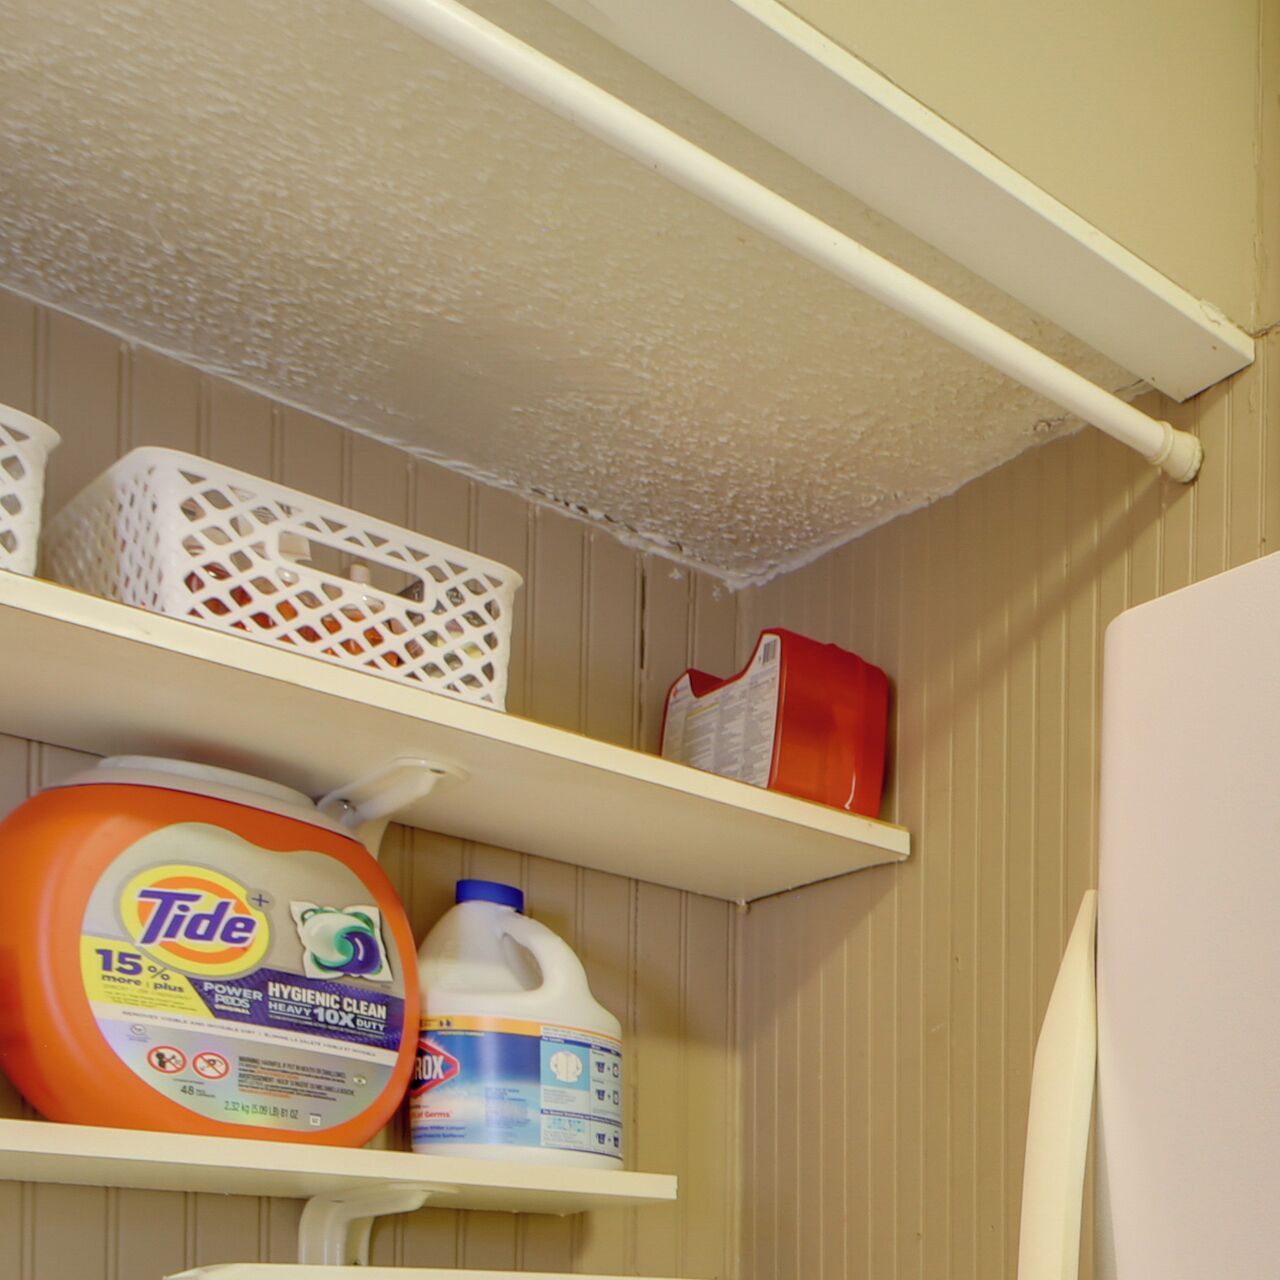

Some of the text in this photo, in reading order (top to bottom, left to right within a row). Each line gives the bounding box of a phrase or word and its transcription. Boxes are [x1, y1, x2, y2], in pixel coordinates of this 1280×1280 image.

[138, 889, 257, 944] Tide
[101, 974, 142, 986] more
[153, 981, 185, 993] plus
[203, 982, 263, 1001] POWER
[268, 981, 387, 1020] HYGIENIC CLEAN
[268, 1001, 312, 1016] HEAVY
[313, 1007, 356, 1029] 10X
[356, 1019, 386, 1031] DUTY
